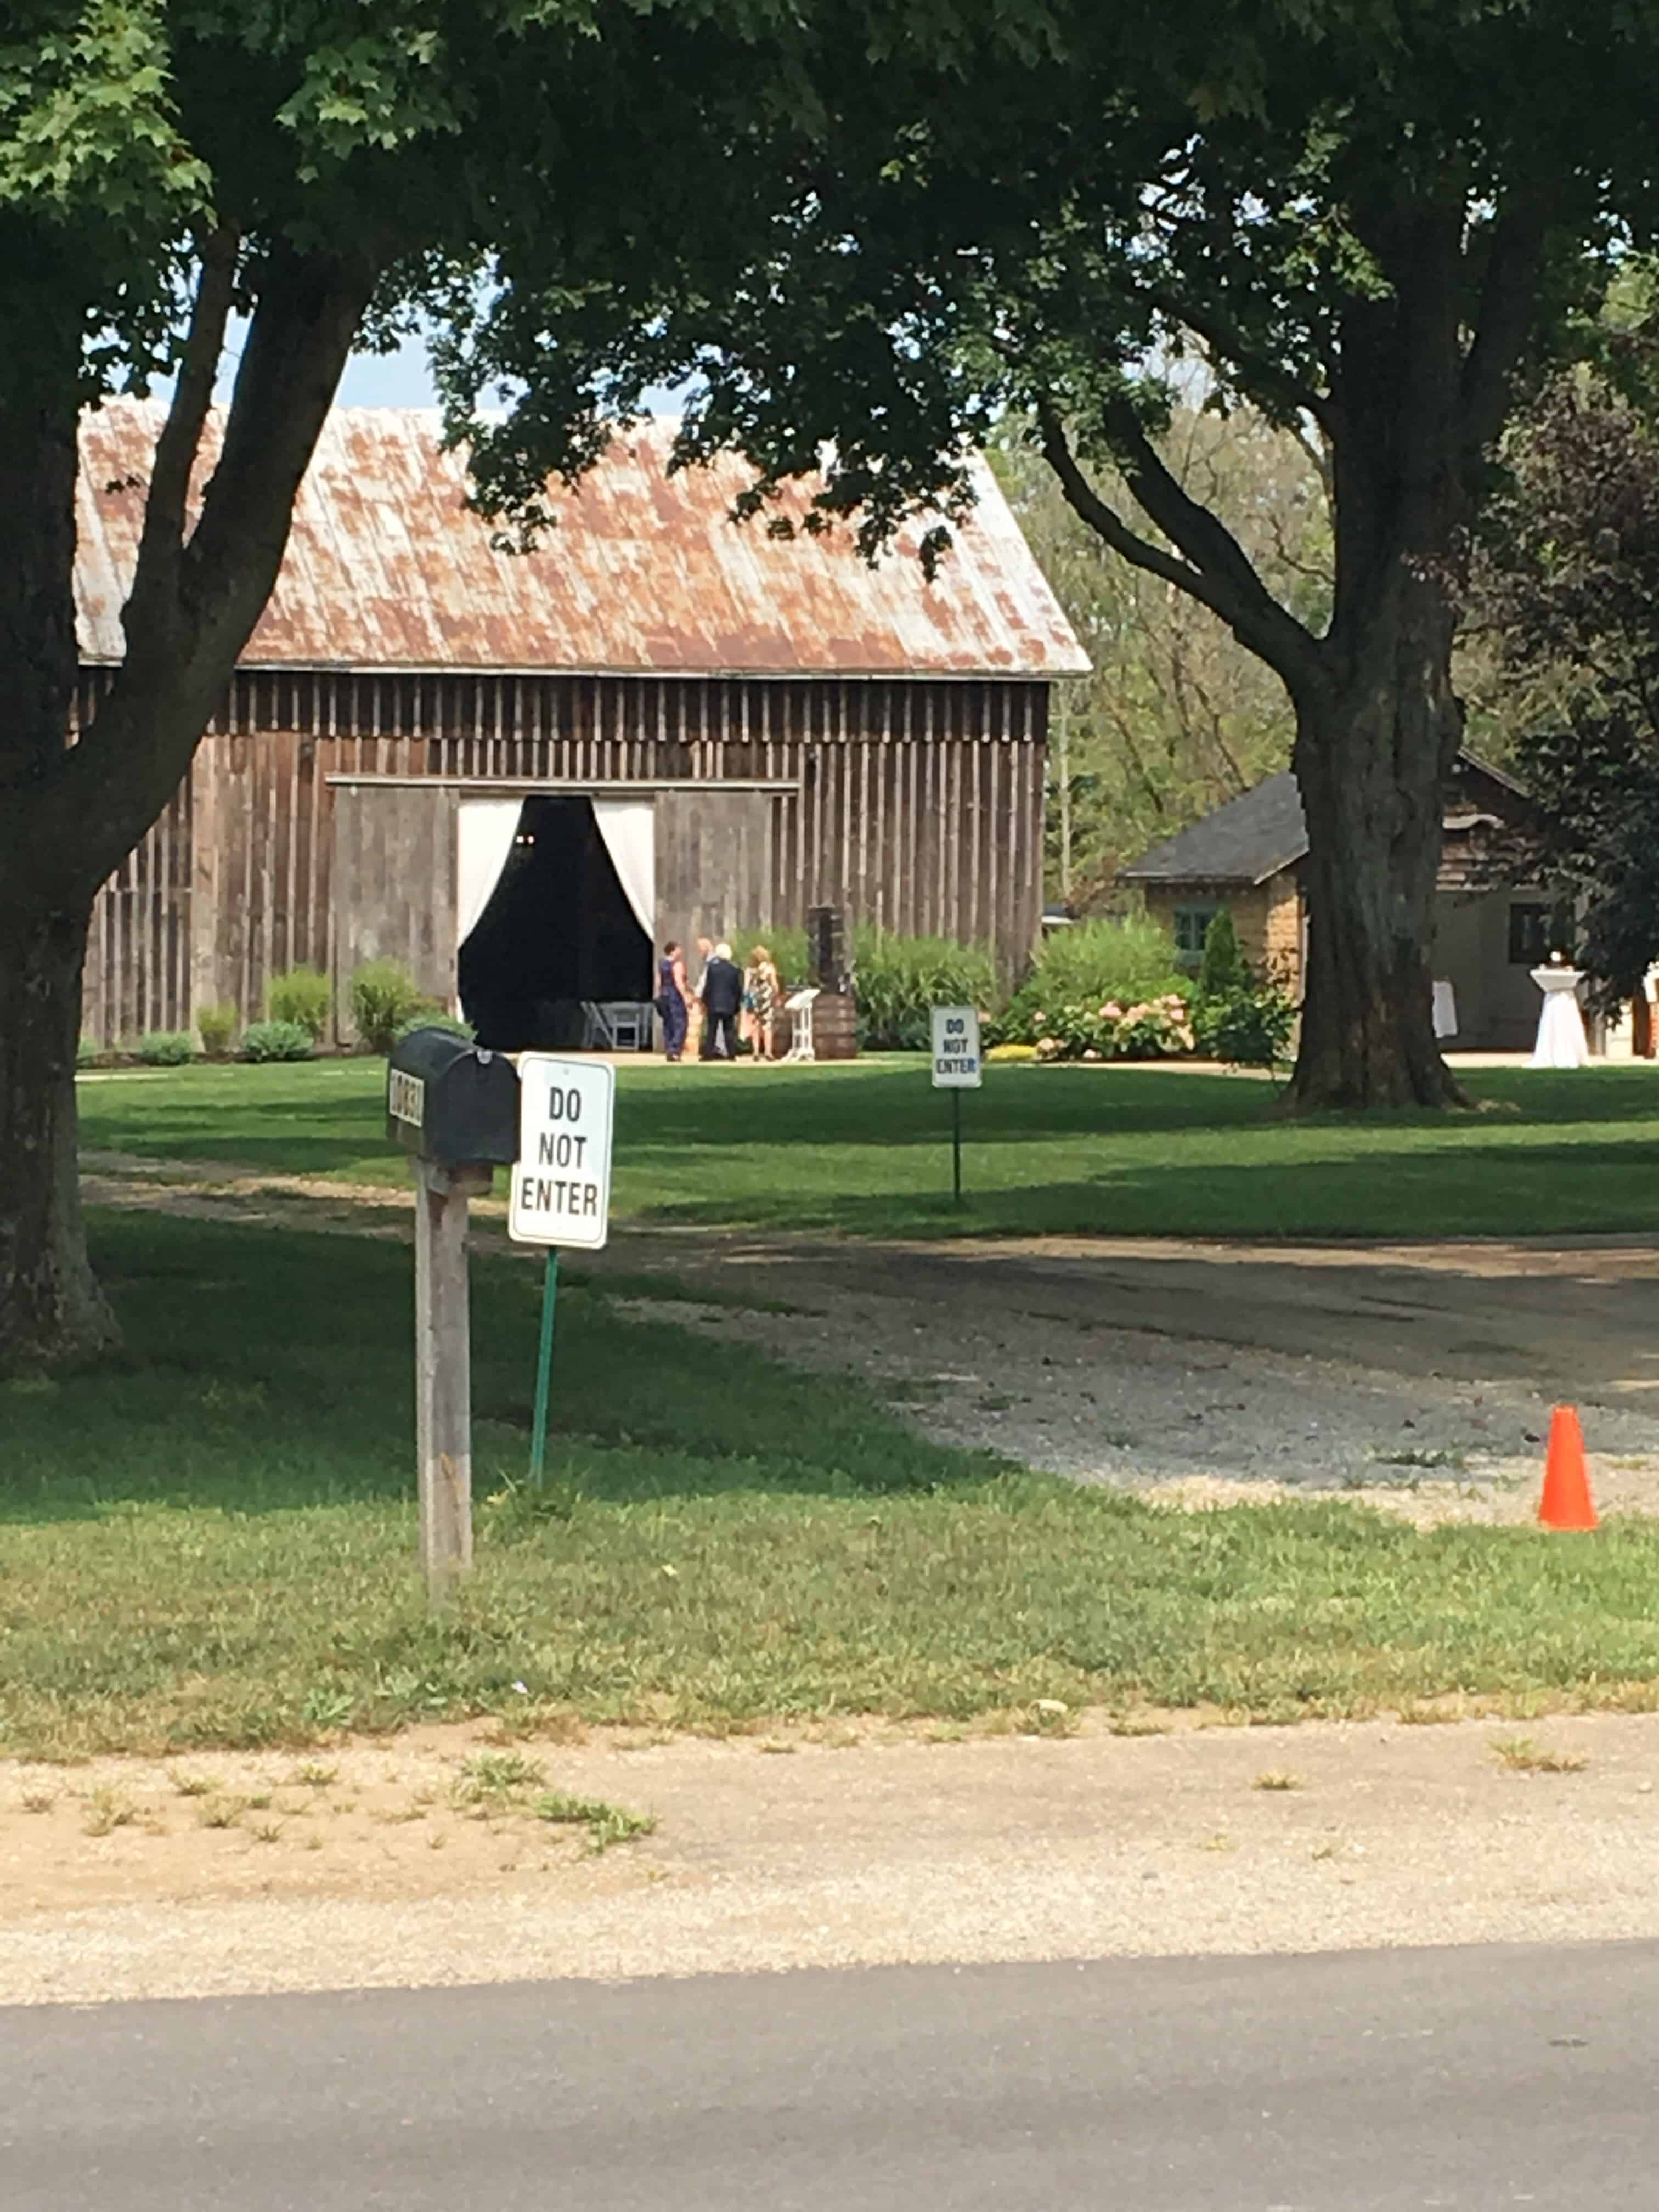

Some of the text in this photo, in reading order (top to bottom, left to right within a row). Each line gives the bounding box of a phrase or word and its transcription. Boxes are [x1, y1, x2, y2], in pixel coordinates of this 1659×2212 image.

[946, 1019, 964, 1034] DO
[944, 1039, 968, 1053] NOT
[936, 1057, 976, 1074] ENTER
[549, 1086, 581, 1122] DO
[539, 1132, 587, 1169] NOT
[522, 1177, 597, 1217] ENTER
